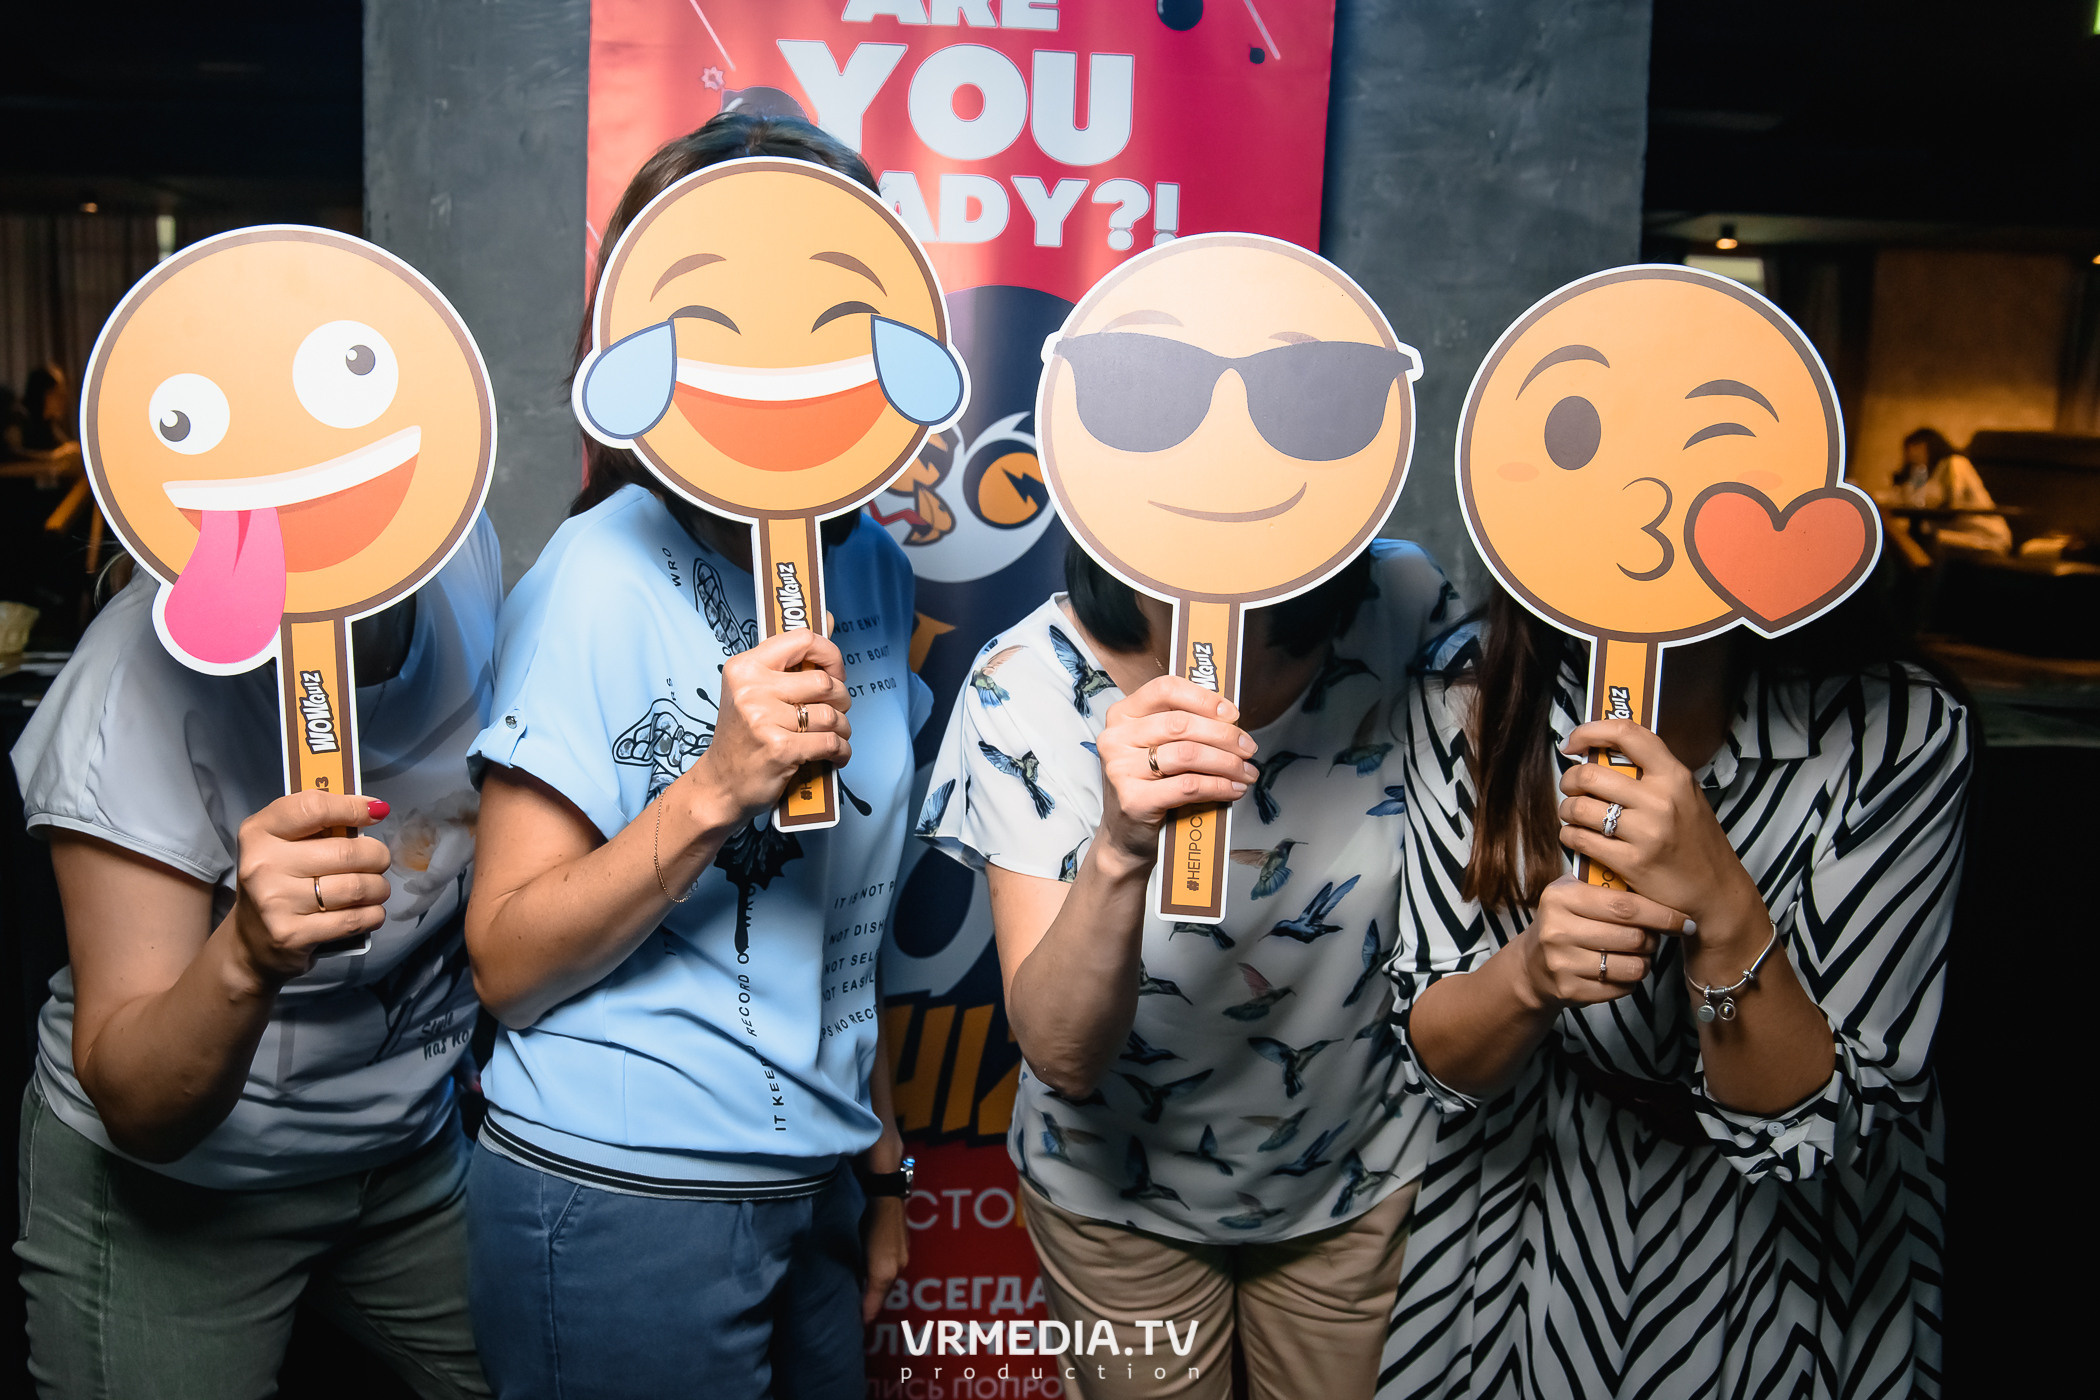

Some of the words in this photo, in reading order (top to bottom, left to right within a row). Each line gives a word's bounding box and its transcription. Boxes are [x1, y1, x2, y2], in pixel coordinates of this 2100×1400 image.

[777, 39, 1135, 166] YOU
[878, 170, 1181, 252] ADY?!
[847, 684, 865, 698] OT
[860, 882, 885, 900] NOT
[828, 927, 850, 946] NOT
[738, 974, 758, 1038] RECORD
[834, 1017, 849, 1034] NO
[423, 1038, 447, 1061] has
[761, 1058, 785, 1106] KEEP
[774, 1114, 787, 1131] IT
